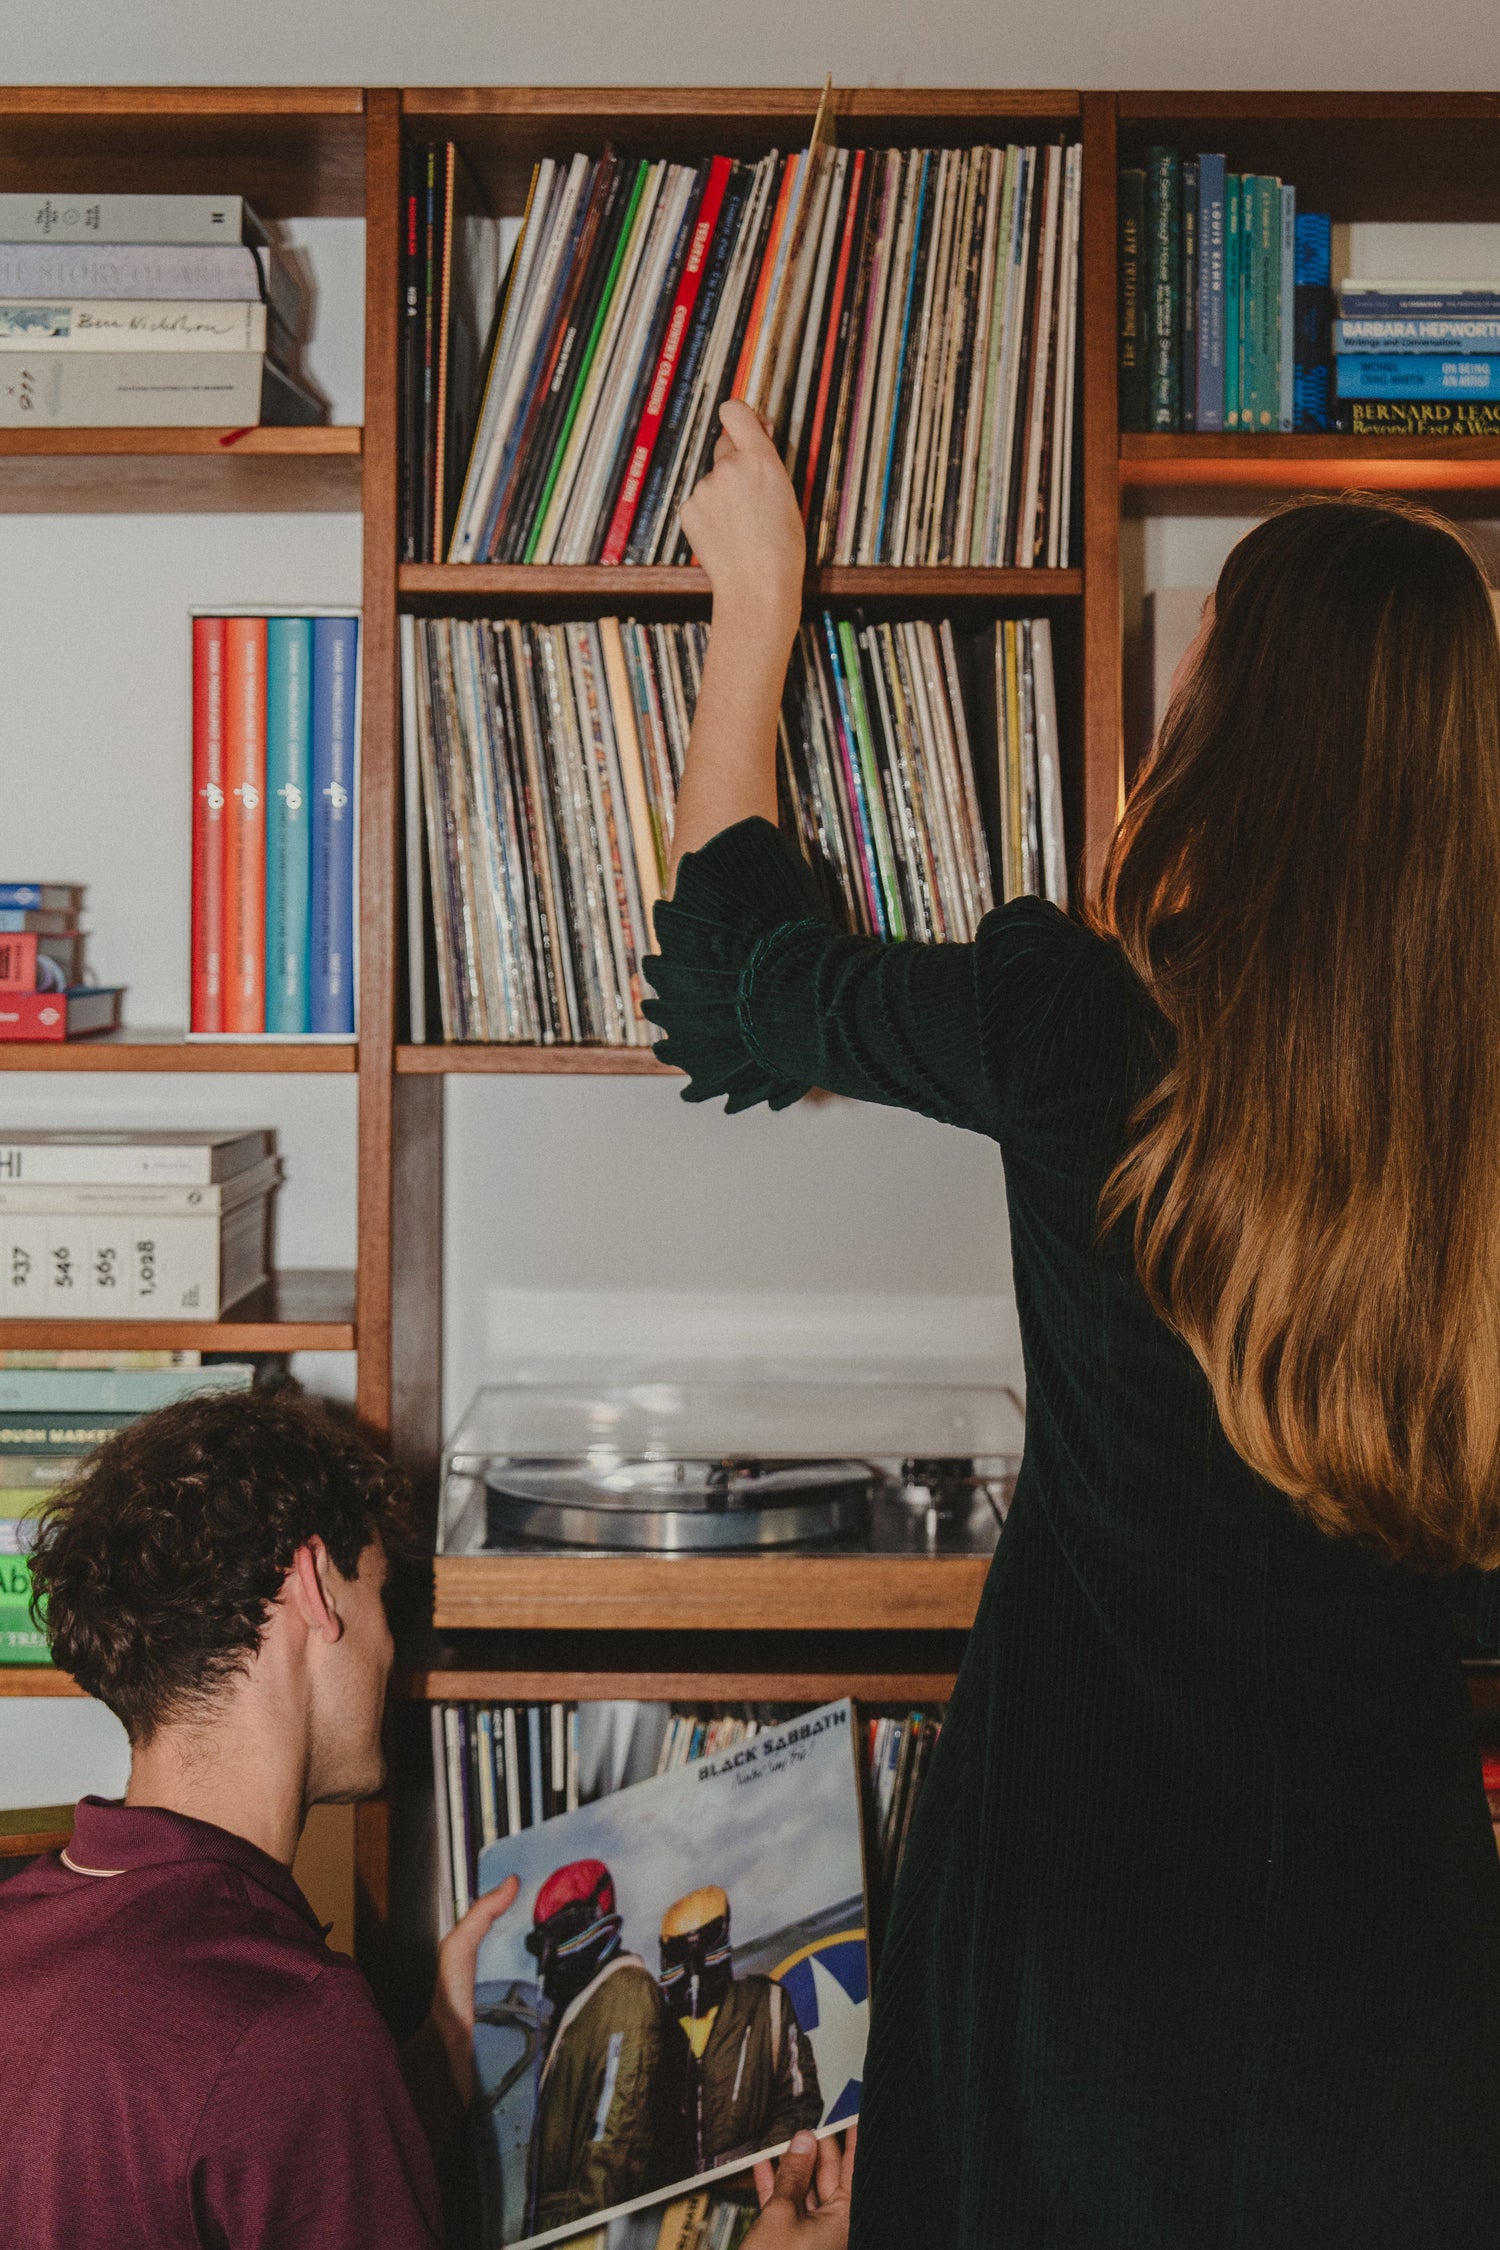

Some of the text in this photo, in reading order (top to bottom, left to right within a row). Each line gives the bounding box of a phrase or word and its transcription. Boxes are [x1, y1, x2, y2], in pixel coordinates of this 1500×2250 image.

[1211, 201, 1221, 244] LOUIS
[1211, 251, 1221, 291] KAHN
[75, 312, 235, 334] Ben Nicholson
[1342, 321, 1417, 337] BARBARA
[647, 305, 687, 416] COUNTRY CLASSICS
[1343, 338, 1462, 348] Writings and Conversations
[1442, 375, 1492, 387] AN ARTIST
[1458, 363, 1492, 375] BEING
[1352, 404, 1451, 421] BERNARD
[1452, 420, 1464, 434] &
[13, 1247, 31, 1286] 237
[54, 1247, 73, 1287] 546
[95, 1248, 116, 1287] 565
[137, 1239, 156, 1296] 1,028
[698, 1709, 847, 1782] BLACK SABBATH
